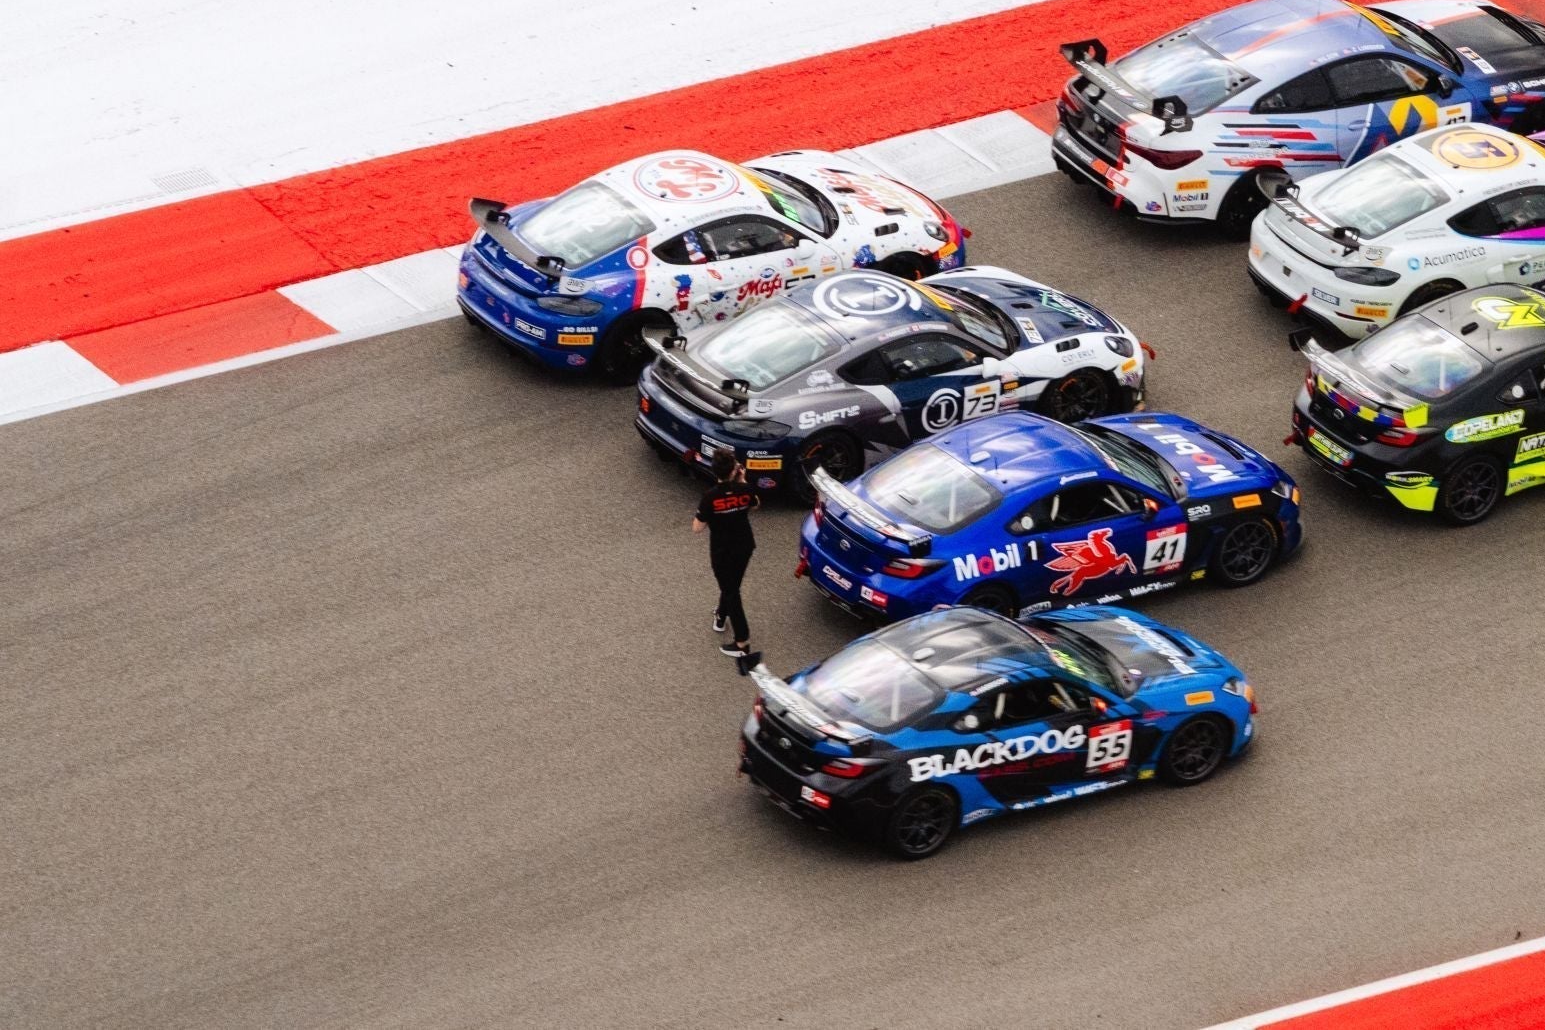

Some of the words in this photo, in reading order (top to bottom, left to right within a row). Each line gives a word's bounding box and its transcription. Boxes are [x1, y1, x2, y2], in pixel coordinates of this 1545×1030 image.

[1173, 193, 1199, 203] Mobil
[1424, 244, 1487, 269] Acumatica
[967, 393, 996, 416] 73
[1452, 409, 1525, 440] COPELAND
[1155, 432, 1241, 483] Mobil
[1187, 504, 1212, 517] SRO
[953, 542, 1021, 582] Mobil
[1027, 539, 1039, 562] 1
[1151, 540, 1179, 563] 41
[907, 724, 1087, 783] BLACKDOG
[1092, 733, 1128, 764] 55
